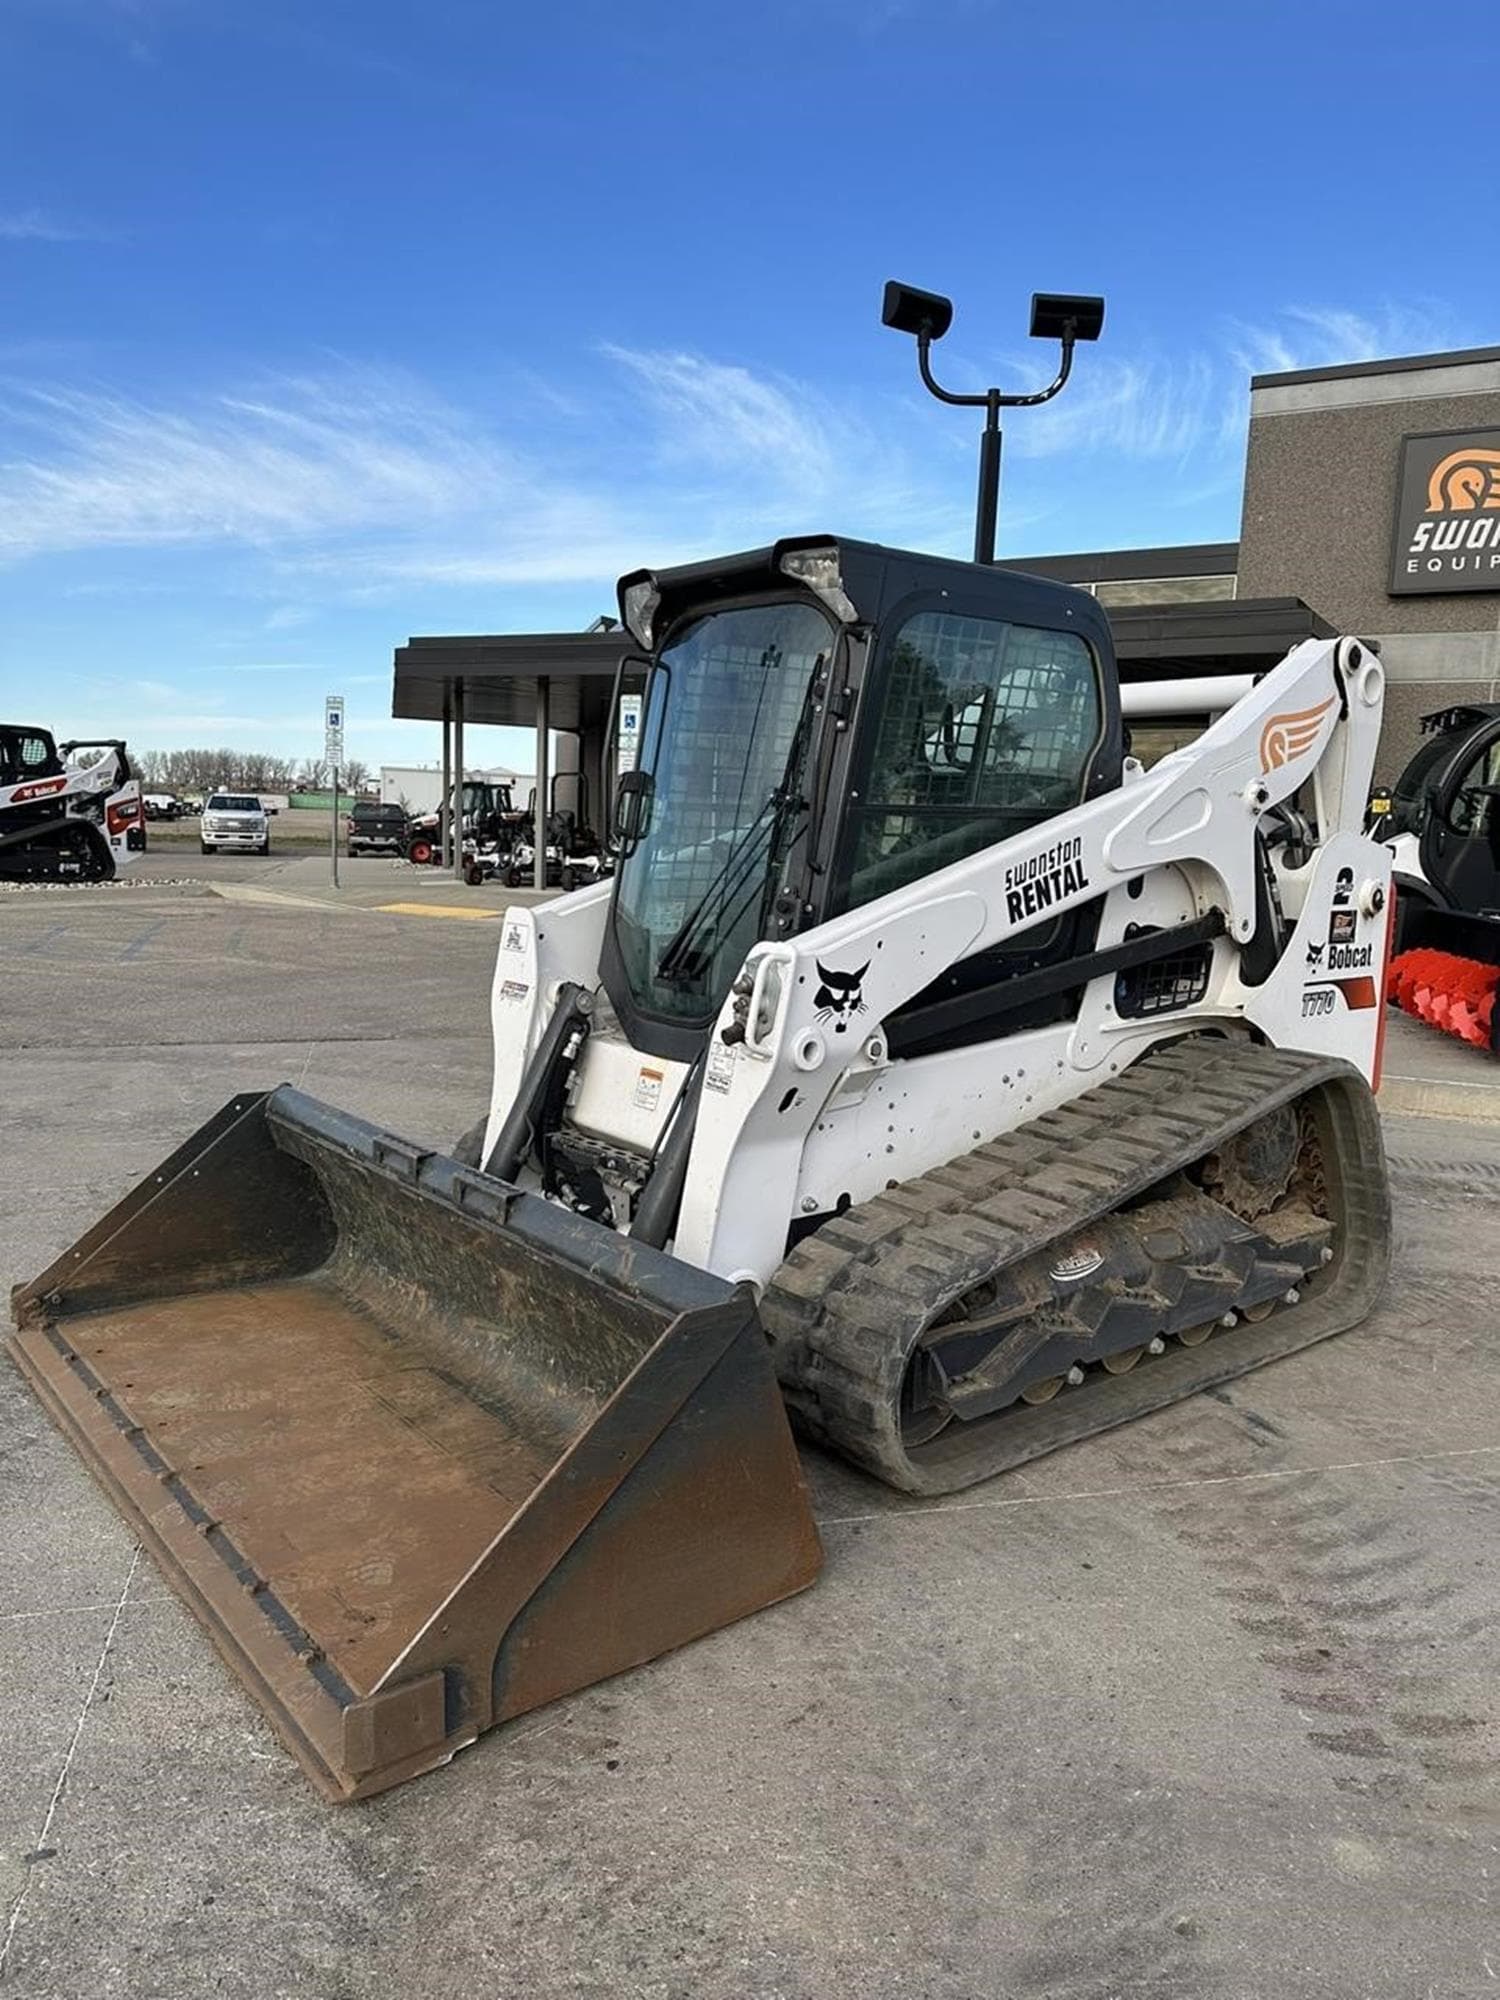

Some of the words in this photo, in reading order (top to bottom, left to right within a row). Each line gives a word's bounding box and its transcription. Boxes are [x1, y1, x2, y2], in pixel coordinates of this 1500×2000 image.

[1407, 554, 1500, 573] EQUIP
[1006, 859, 1089, 925] RENTAL
[1333, 866, 1353, 905] 2
[1328, 943, 1373, 970] Bobcat
[1301, 989, 1336, 1017] T770
